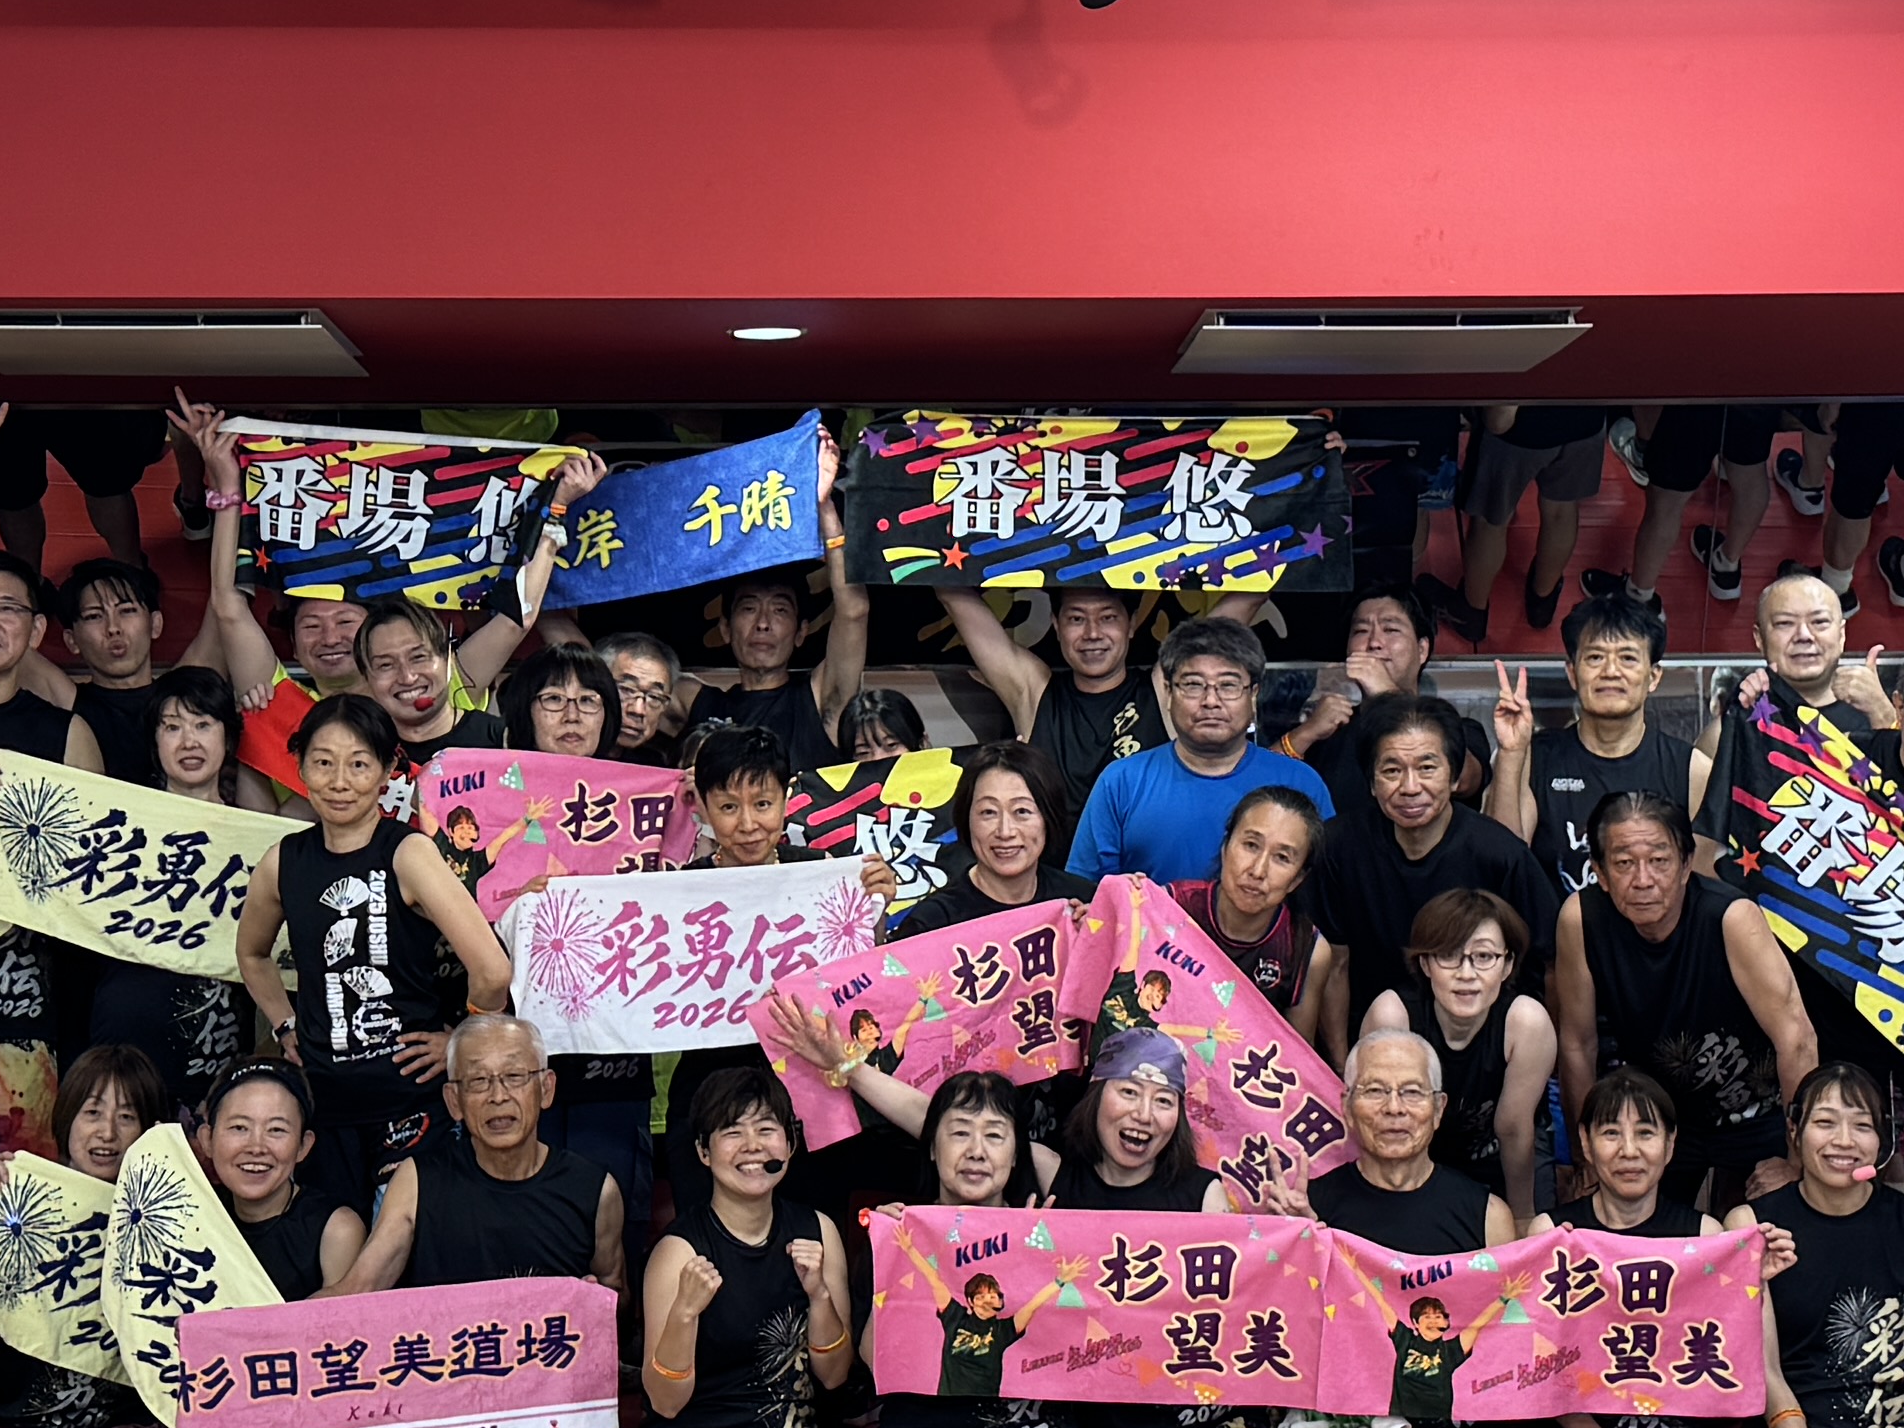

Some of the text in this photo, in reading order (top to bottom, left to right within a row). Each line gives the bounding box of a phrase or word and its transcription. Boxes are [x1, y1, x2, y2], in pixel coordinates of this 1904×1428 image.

[250, 456, 433, 560] 番場
[553, 470, 797, 570] 岸 千晴
[940, 447, 1258, 543] 番場 悠
[440, 770, 486, 798] KUKI
[559, 780, 674, 844] 杉田
[62, 808, 255, 917] 彩勇伝
[855, 806, 949, 900] 悠
[102, 909, 211, 951] 2026
[596, 900, 823, 1006] 彩勇伝
[1155, 940, 1206, 978] KUKI
[831, 972, 873, 1009] KUKI
[951, 926, 1057, 1006] 杉田
[652, 989, 755, 1029] 2026
[185, 1058, 233, 1077] 202
[1229, 1043, 1346, 1158] 杉田
[955, 1231, 1008, 1267] KUKI
[1098, 1236, 1238, 1302] 杉田
[1400, 1260, 1453, 1291] KUKI
[1542, 1250, 1676, 1314] 杉田
[177, 1314, 581, 1413] 杉田望美道場
[1164, 1312, 1300, 1380] 望美
[1600, 1323, 1742, 1389] 望美
[1178, 1404, 1232, 1426] 202
